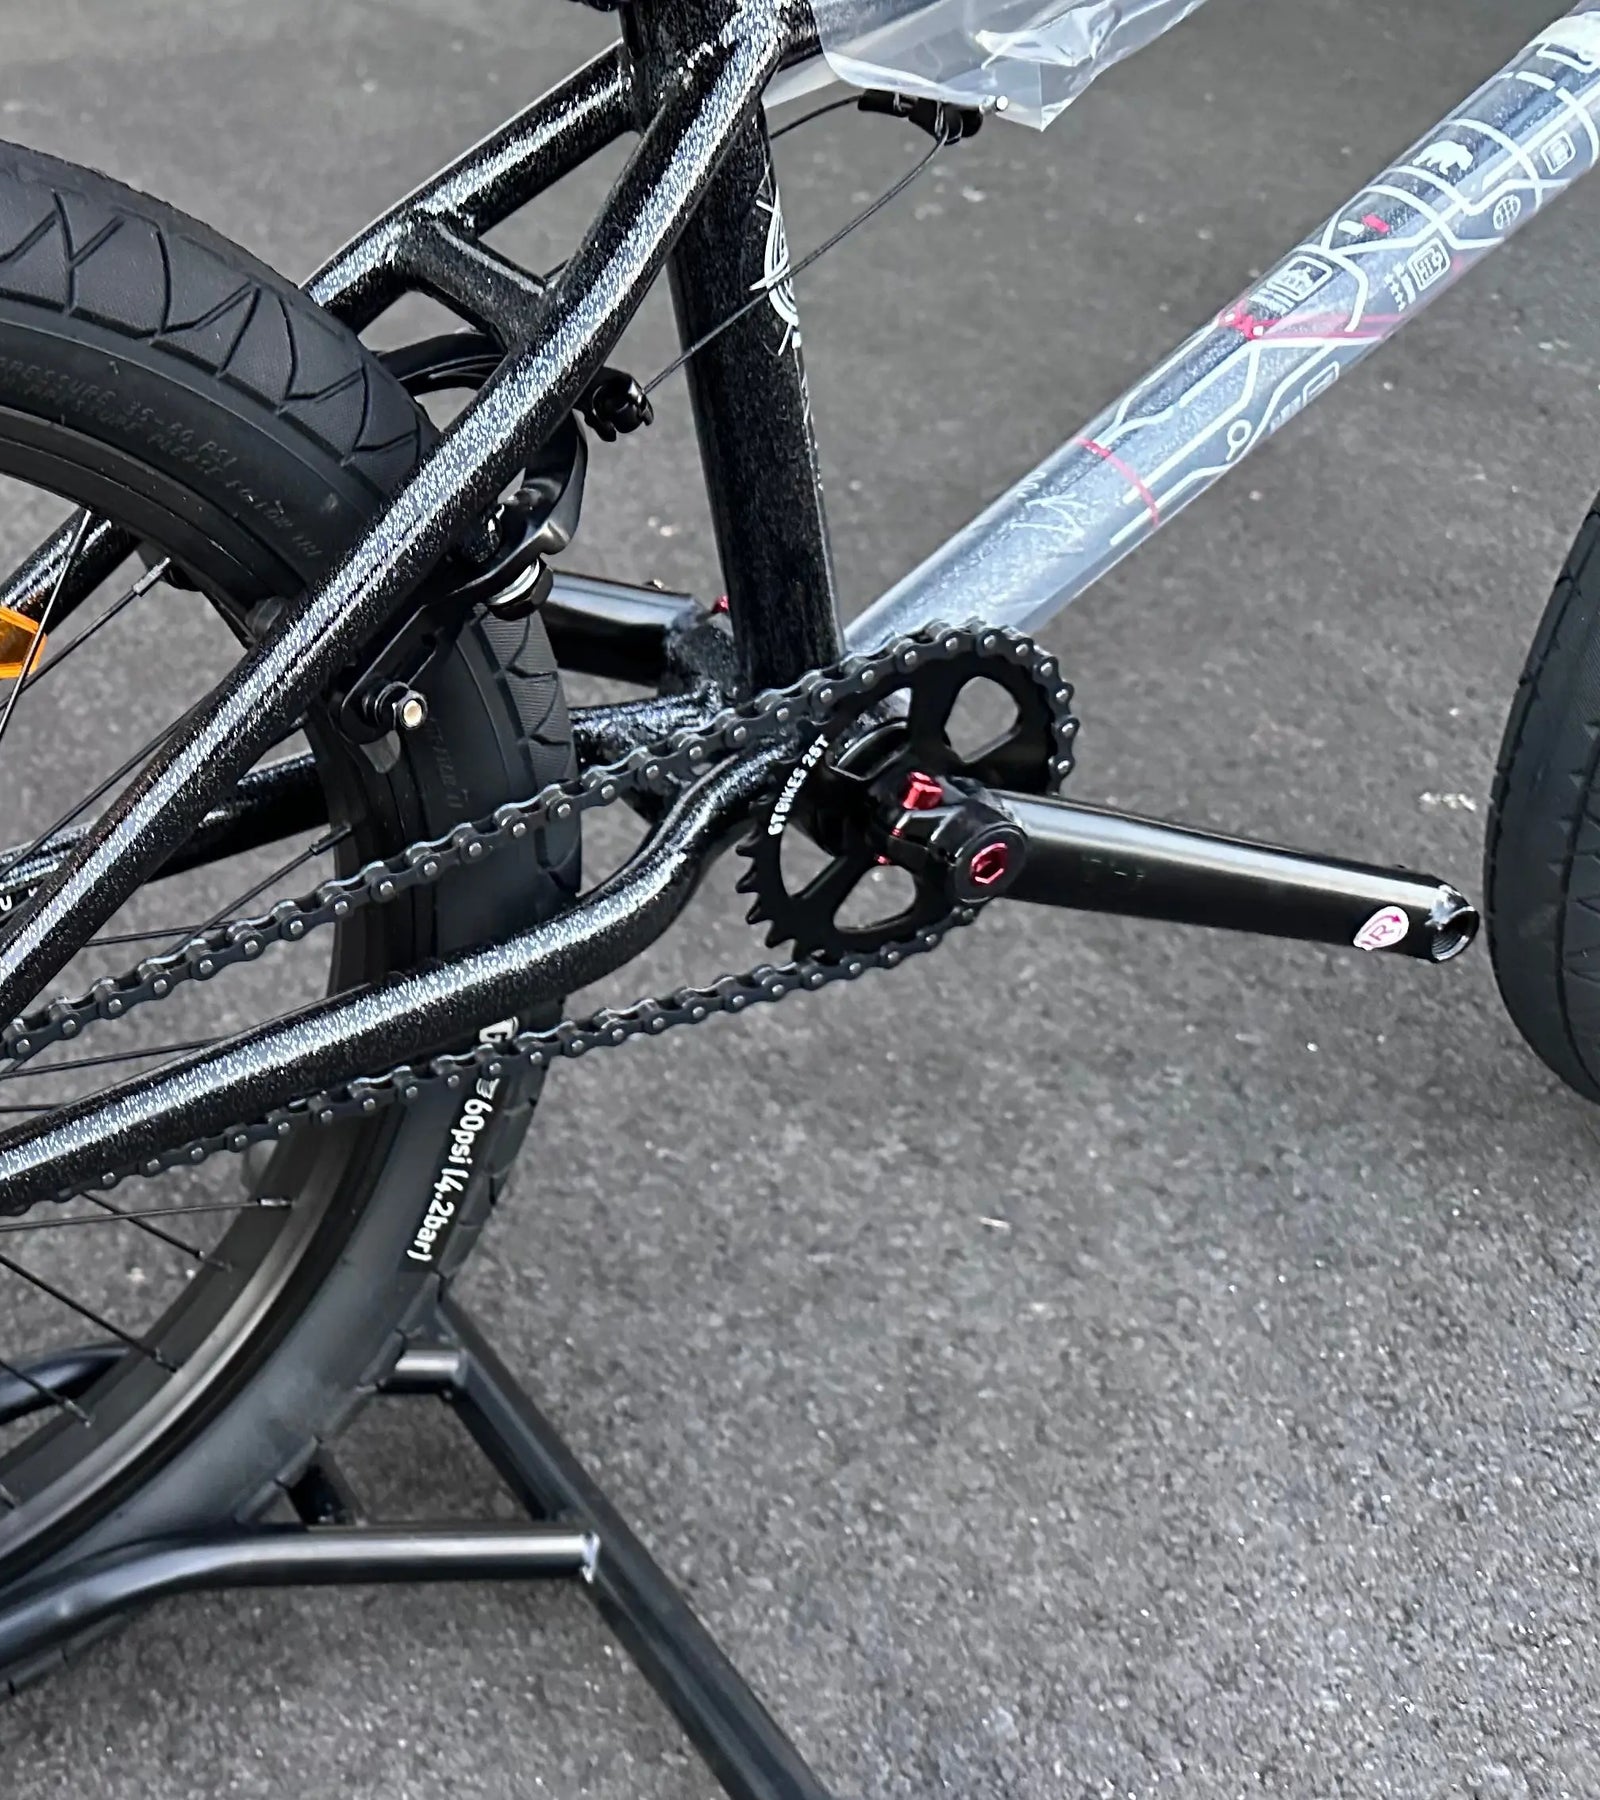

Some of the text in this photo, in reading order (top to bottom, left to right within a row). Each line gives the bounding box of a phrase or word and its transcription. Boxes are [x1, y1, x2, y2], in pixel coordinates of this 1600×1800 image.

[198, 440, 239, 469] PSI
[1368, 924, 1396, 942] R
[406, 1098, 494, 1262] 60psi (4.2bar)
